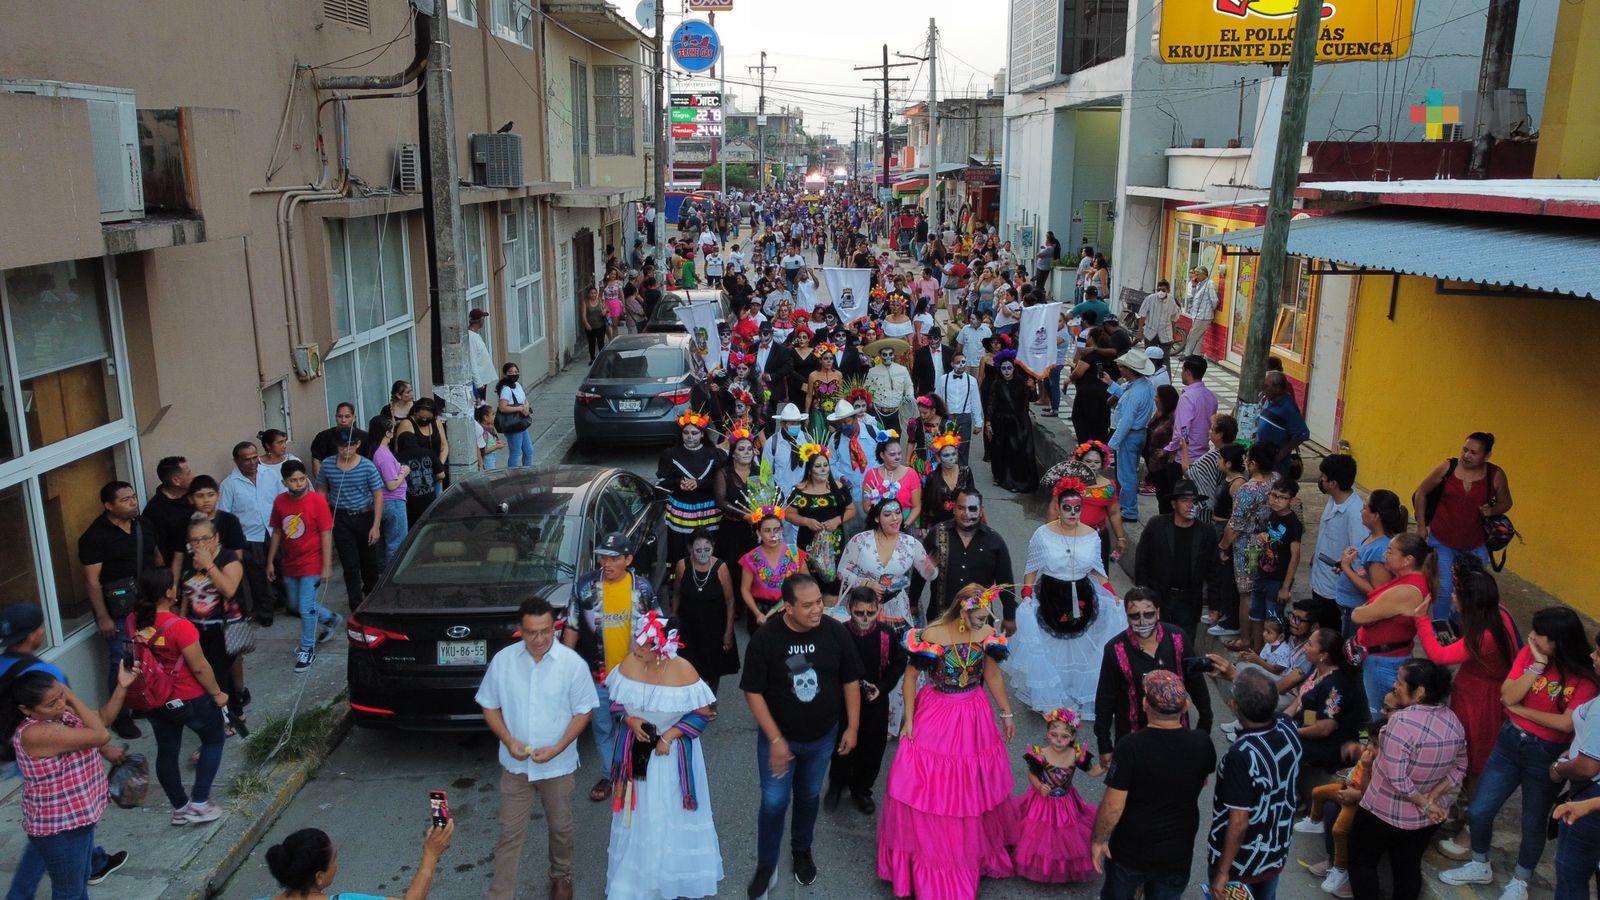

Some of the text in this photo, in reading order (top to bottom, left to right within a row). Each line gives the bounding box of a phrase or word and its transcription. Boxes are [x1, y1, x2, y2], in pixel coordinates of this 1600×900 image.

[1220, 29, 1240, 42] EL
[1320, 25, 1344, 41] ÁS
[1168, 43, 1265, 61] KRUJIENTE
[1269, 43, 1292, 56] DE
[1322, 42, 1394, 56] CUENCA
[440, 646, 485, 657] YKU-86-55
[788, 643, 815, 655] JULIO
